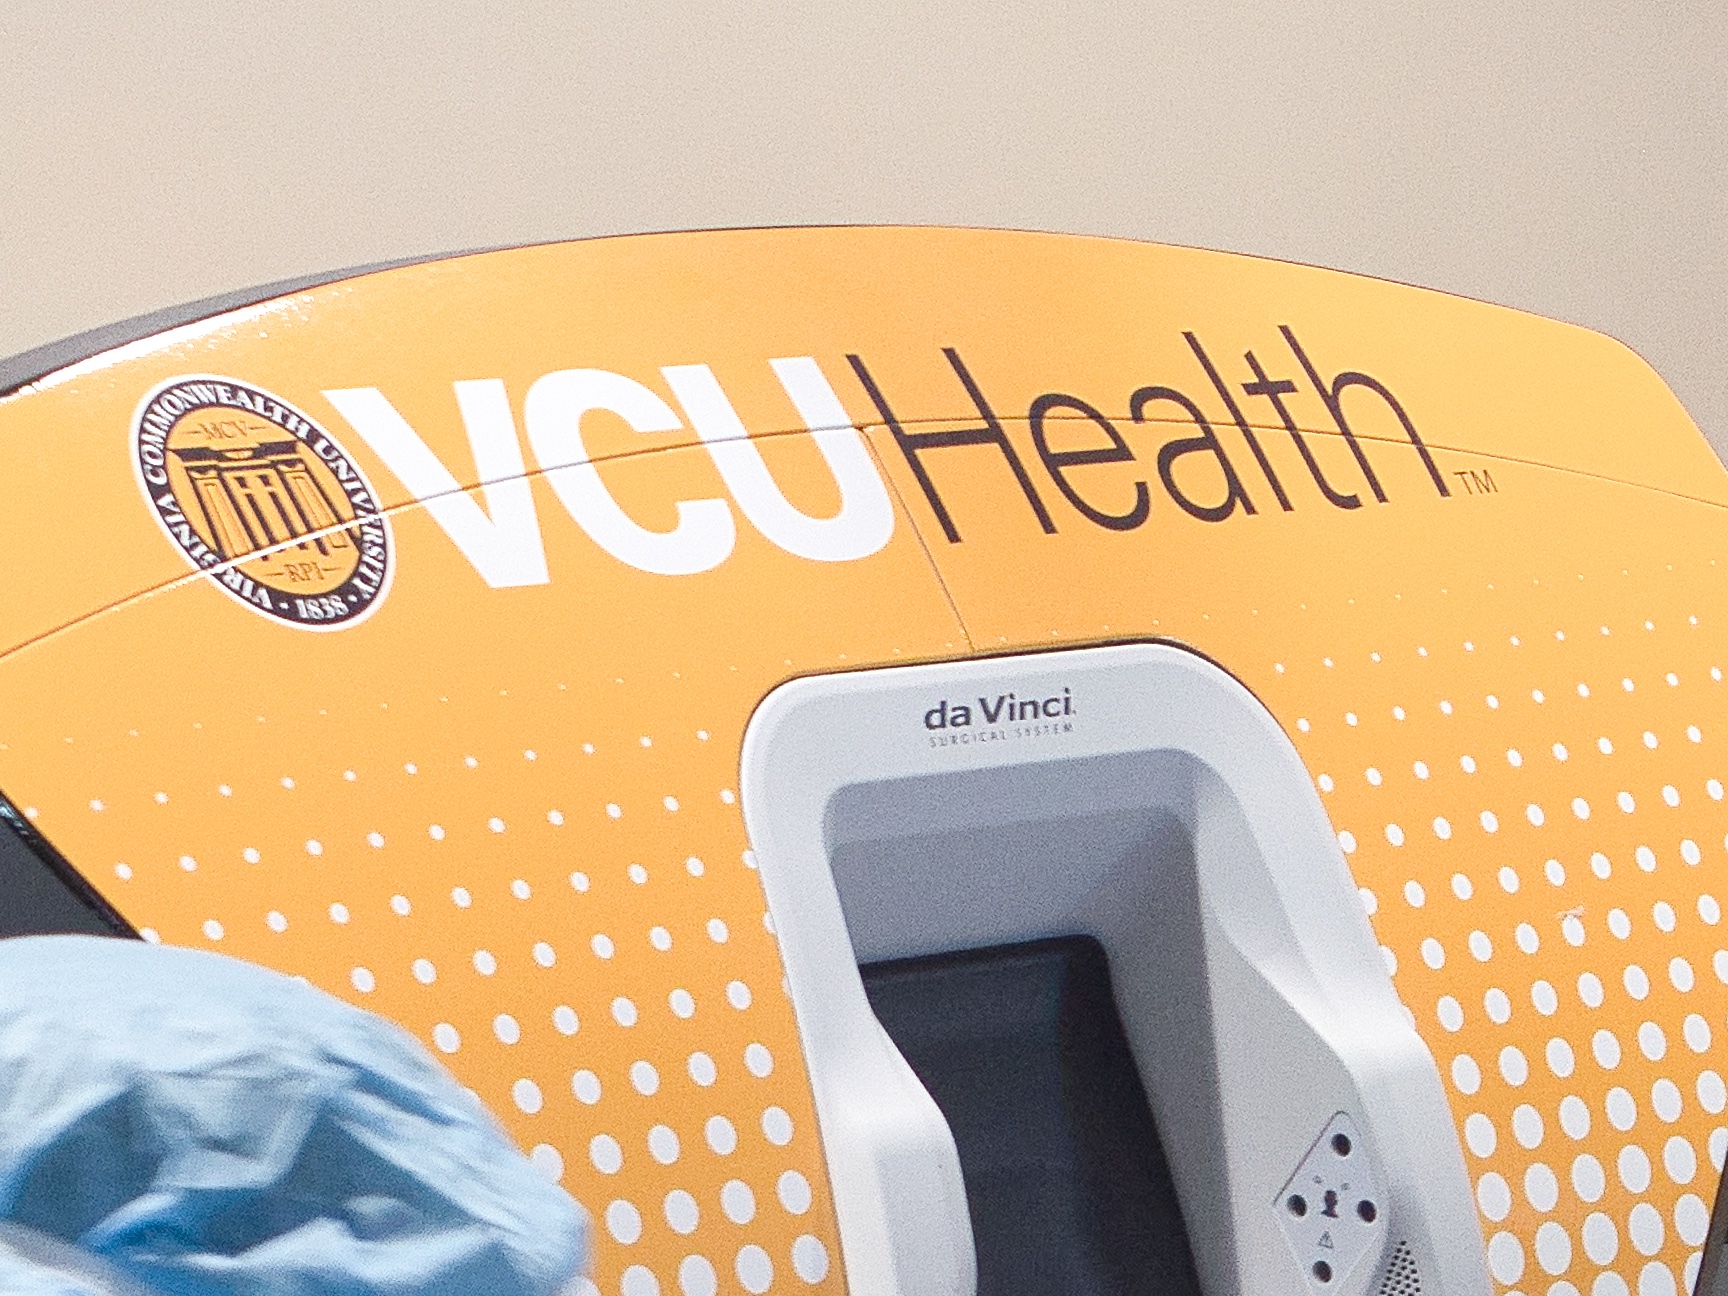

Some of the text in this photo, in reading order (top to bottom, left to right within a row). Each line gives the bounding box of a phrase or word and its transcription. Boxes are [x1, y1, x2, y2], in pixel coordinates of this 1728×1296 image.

[200, 419, 251, 441] MCV
[140, 383, 388, 621] VIRGINIA COMMONWEALTH UNIVERSITY 1838
[924, 686, 1073, 731] da Vinci
